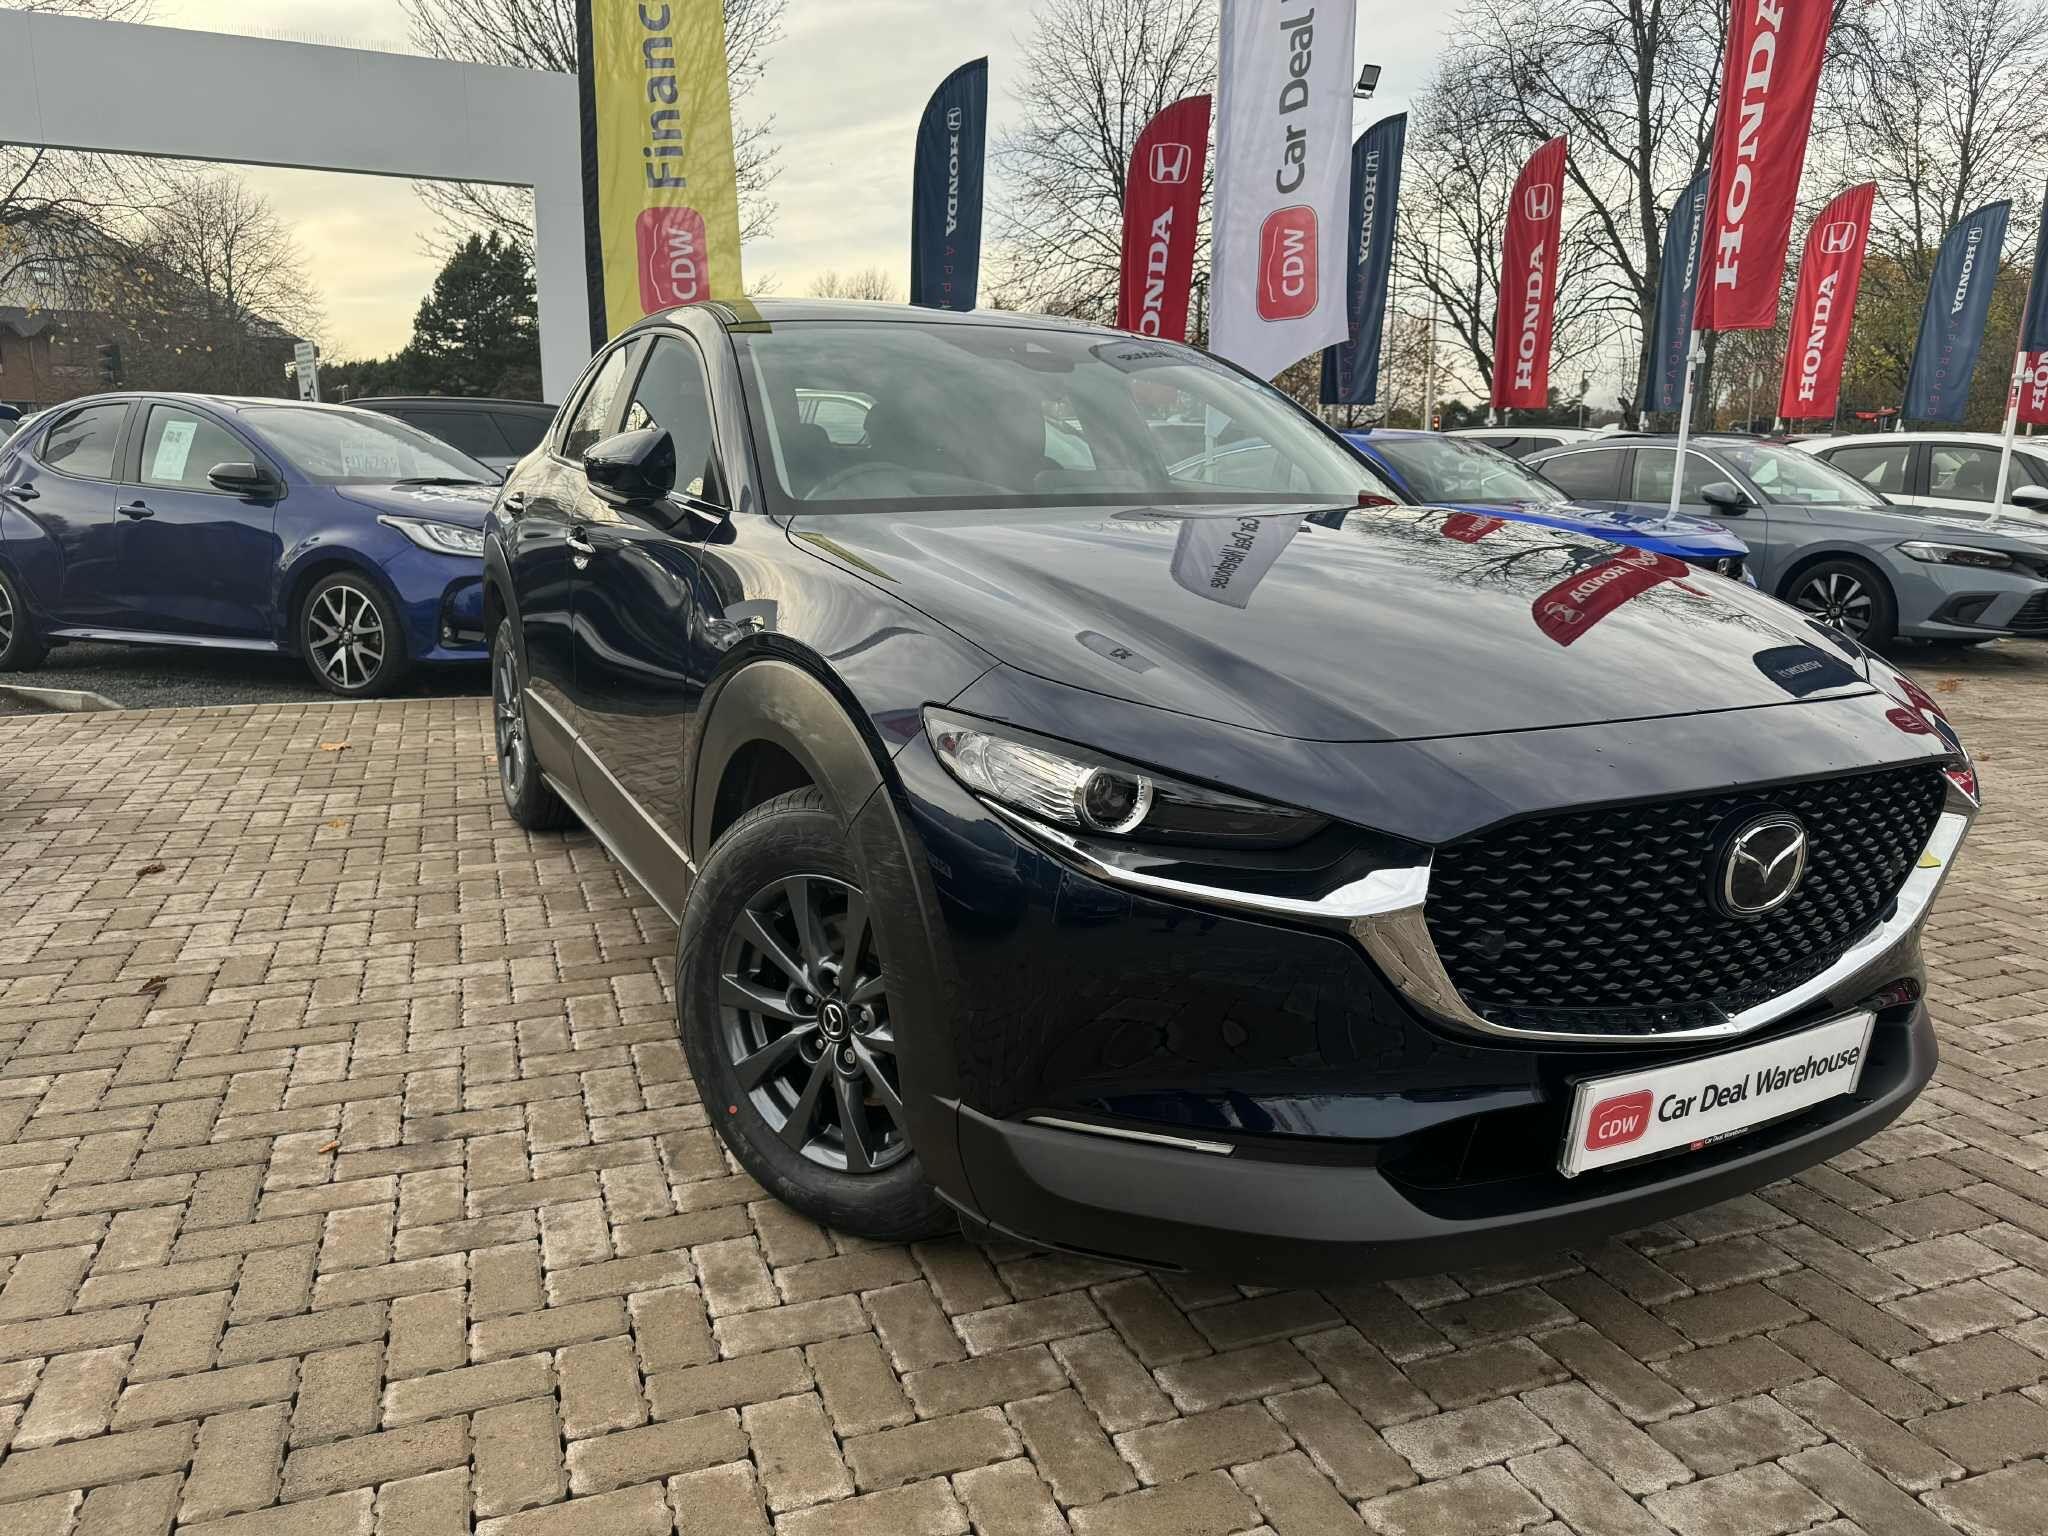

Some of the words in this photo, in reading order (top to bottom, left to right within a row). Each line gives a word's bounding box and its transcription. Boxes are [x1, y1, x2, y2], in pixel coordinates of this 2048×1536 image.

[639, 3, 687, 188] Financ
[1279, 7, 1314, 115] Deal
[945, 133, 959, 237] HONDA
[1276, 124, 1307, 194] Car
[1358, 174, 1377, 265] HONDA
[1682, 213, 1701, 293] HONDA
[668, 228, 697, 300] CDW
[1139, 205, 1173, 337] ONDA
[1282, 228, 1305, 297] CDW
[1951, 244, 1977, 314] HONDA
[1515, 240, 1544, 390] HONDA
[1799, 270, 1839, 401] HONDA
[1598, 1115, 1640, 1139] CDW
[1658, 1094, 1697, 1123] Car
[1700, 1074, 1750, 1112] Deal
[1756, 1046, 1860, 1096] Warehouse
